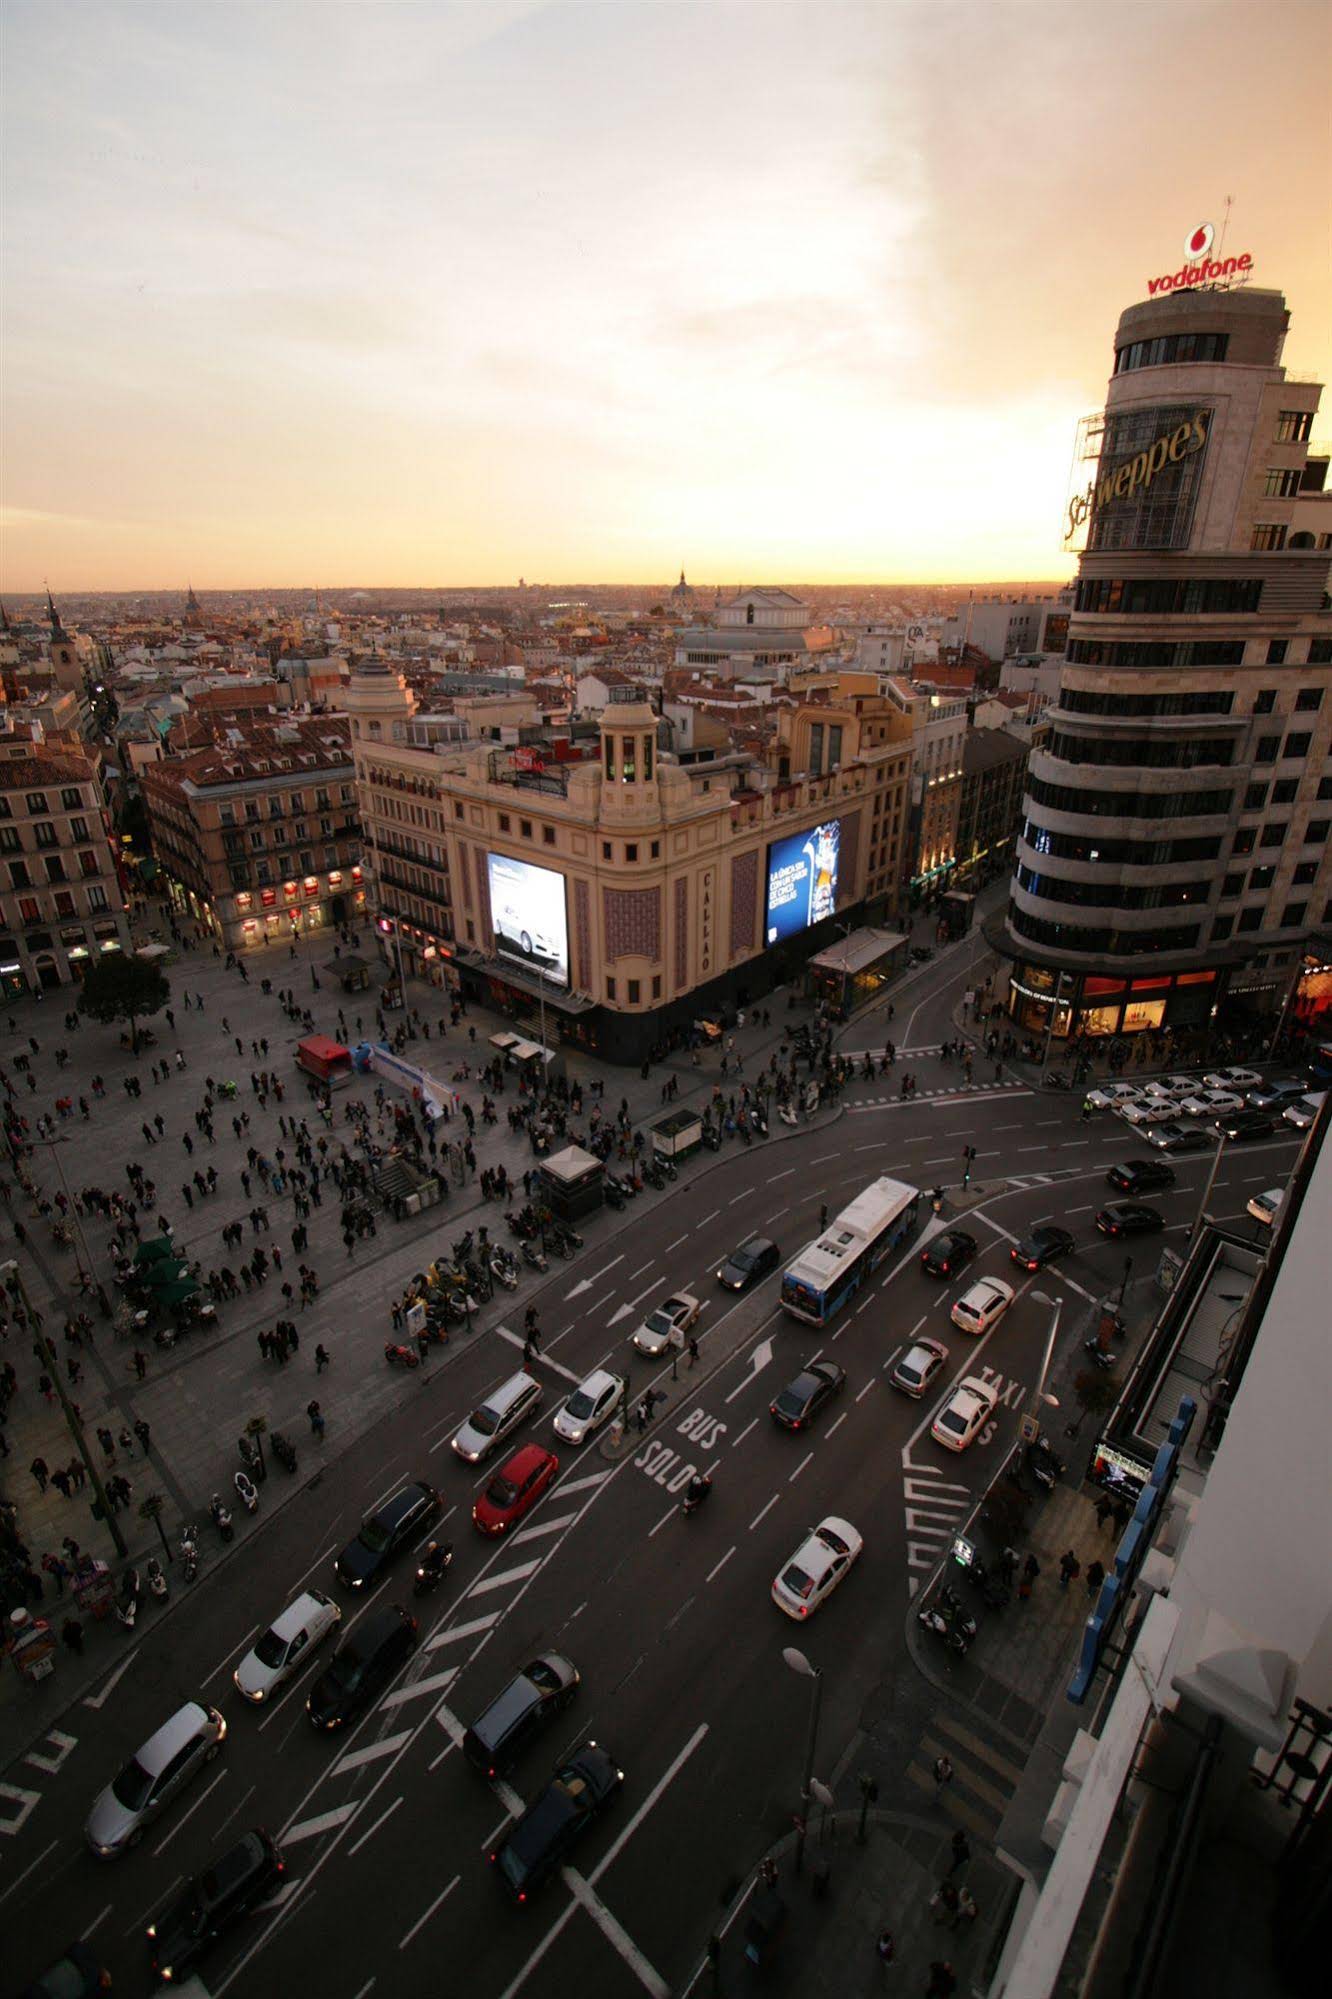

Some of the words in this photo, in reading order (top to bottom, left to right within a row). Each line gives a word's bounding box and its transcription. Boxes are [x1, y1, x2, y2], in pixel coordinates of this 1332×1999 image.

[1147, 253, 1252, 294] vodafone
[1064, 409, 1210, 541] Schweppes
[703, 873, 711, 970] CALLAO
[981, 1365, 1027, 1410] TAXI
[676, 1407, 727, 1449] BUS
[634, 1440, 697, 1493] SOLO
